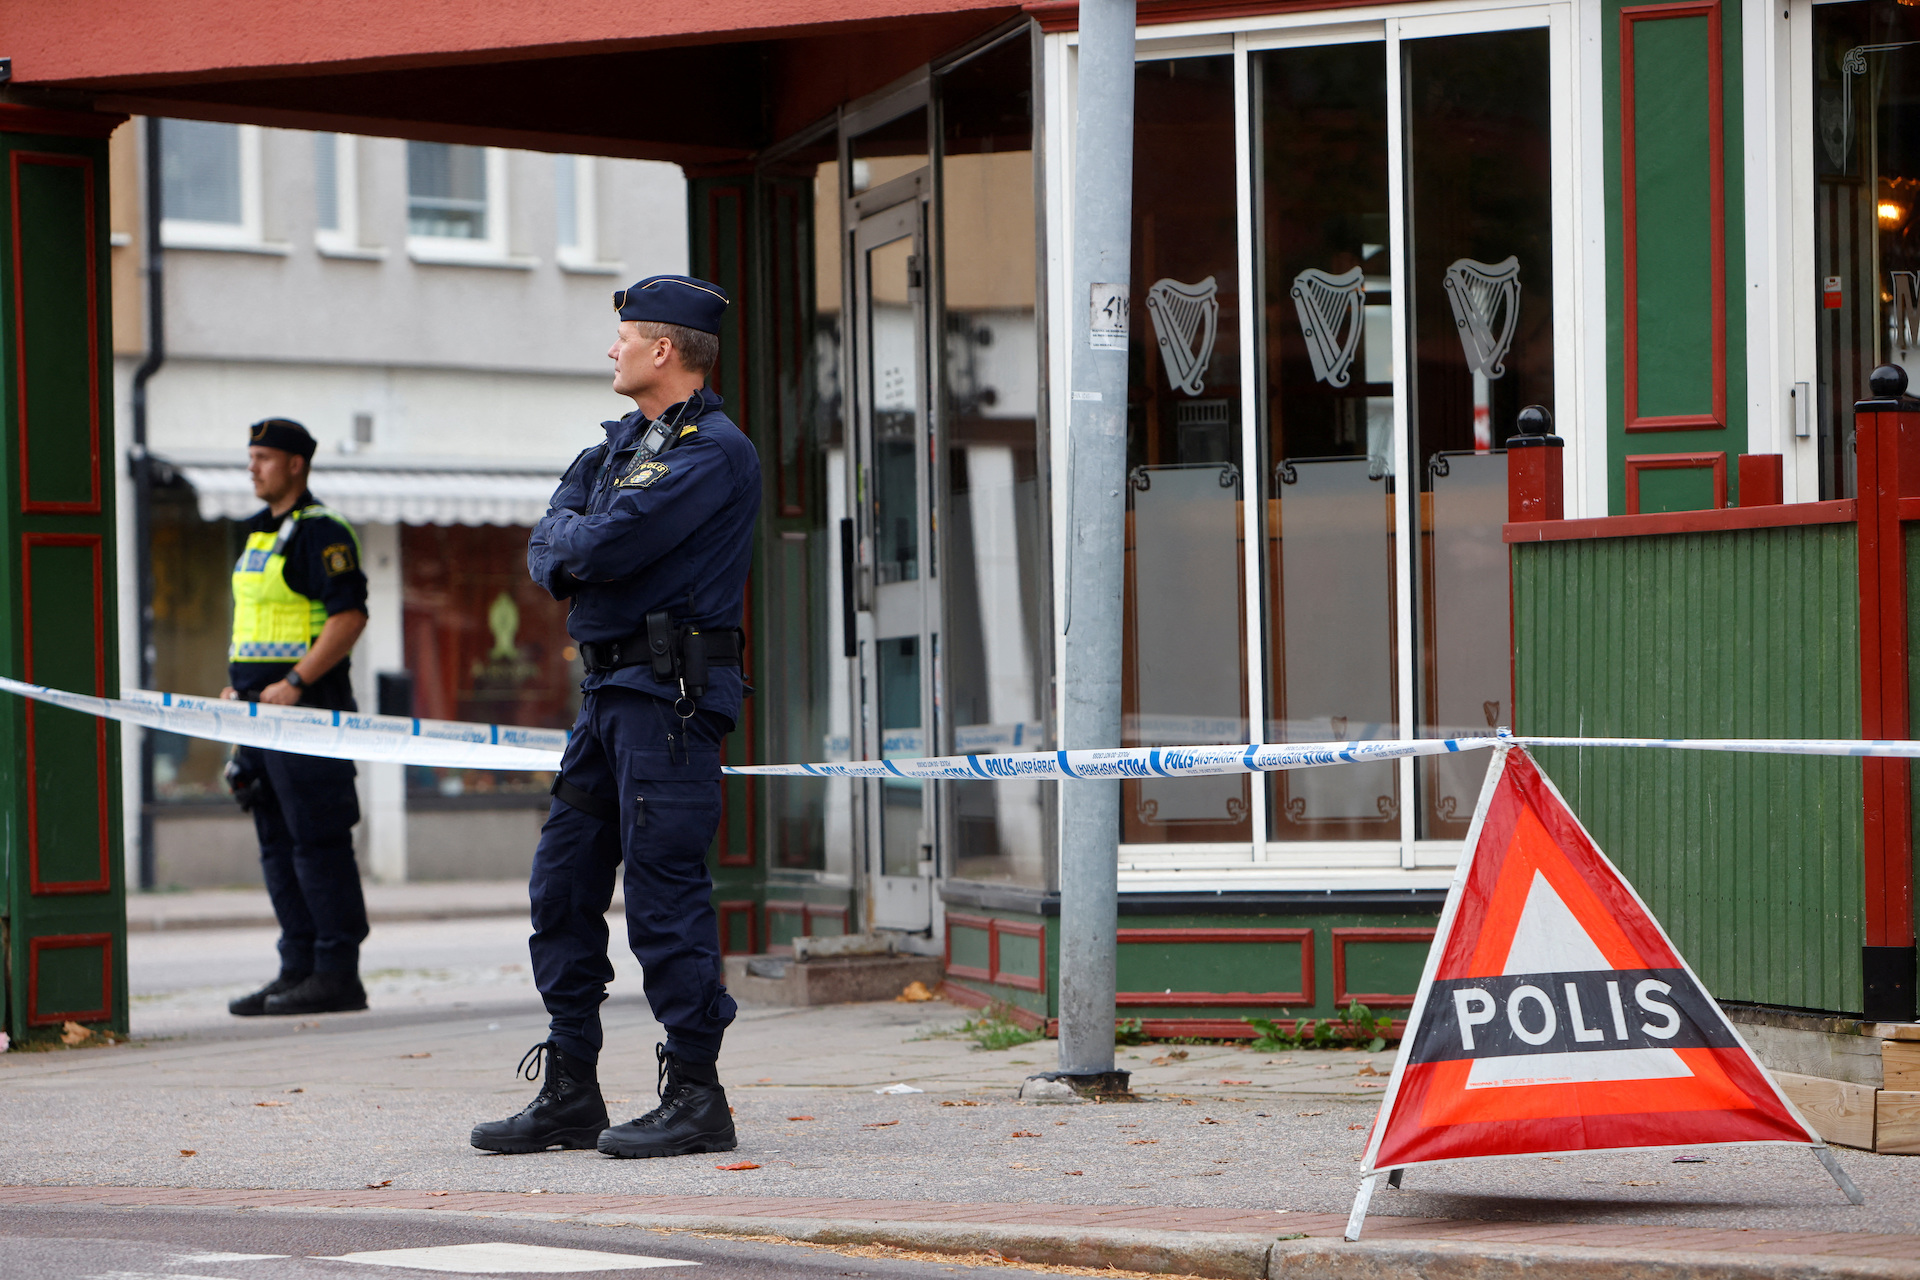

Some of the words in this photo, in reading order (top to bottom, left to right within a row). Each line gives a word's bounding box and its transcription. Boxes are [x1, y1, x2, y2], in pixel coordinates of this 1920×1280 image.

[640, 463, 666, 472] POLIS
[985, 758, 1018, 776] POLIS
[1015, 758, 1057, 774] AVSPÄRRAT
[1117, 758, 1152, 776] POLIS
[1164, 750, 1194, 770] POLIS
[1075, 763, 1118, 777] AVSPÄRRAT
[1453, 978, 1682, 1050] POLIS
